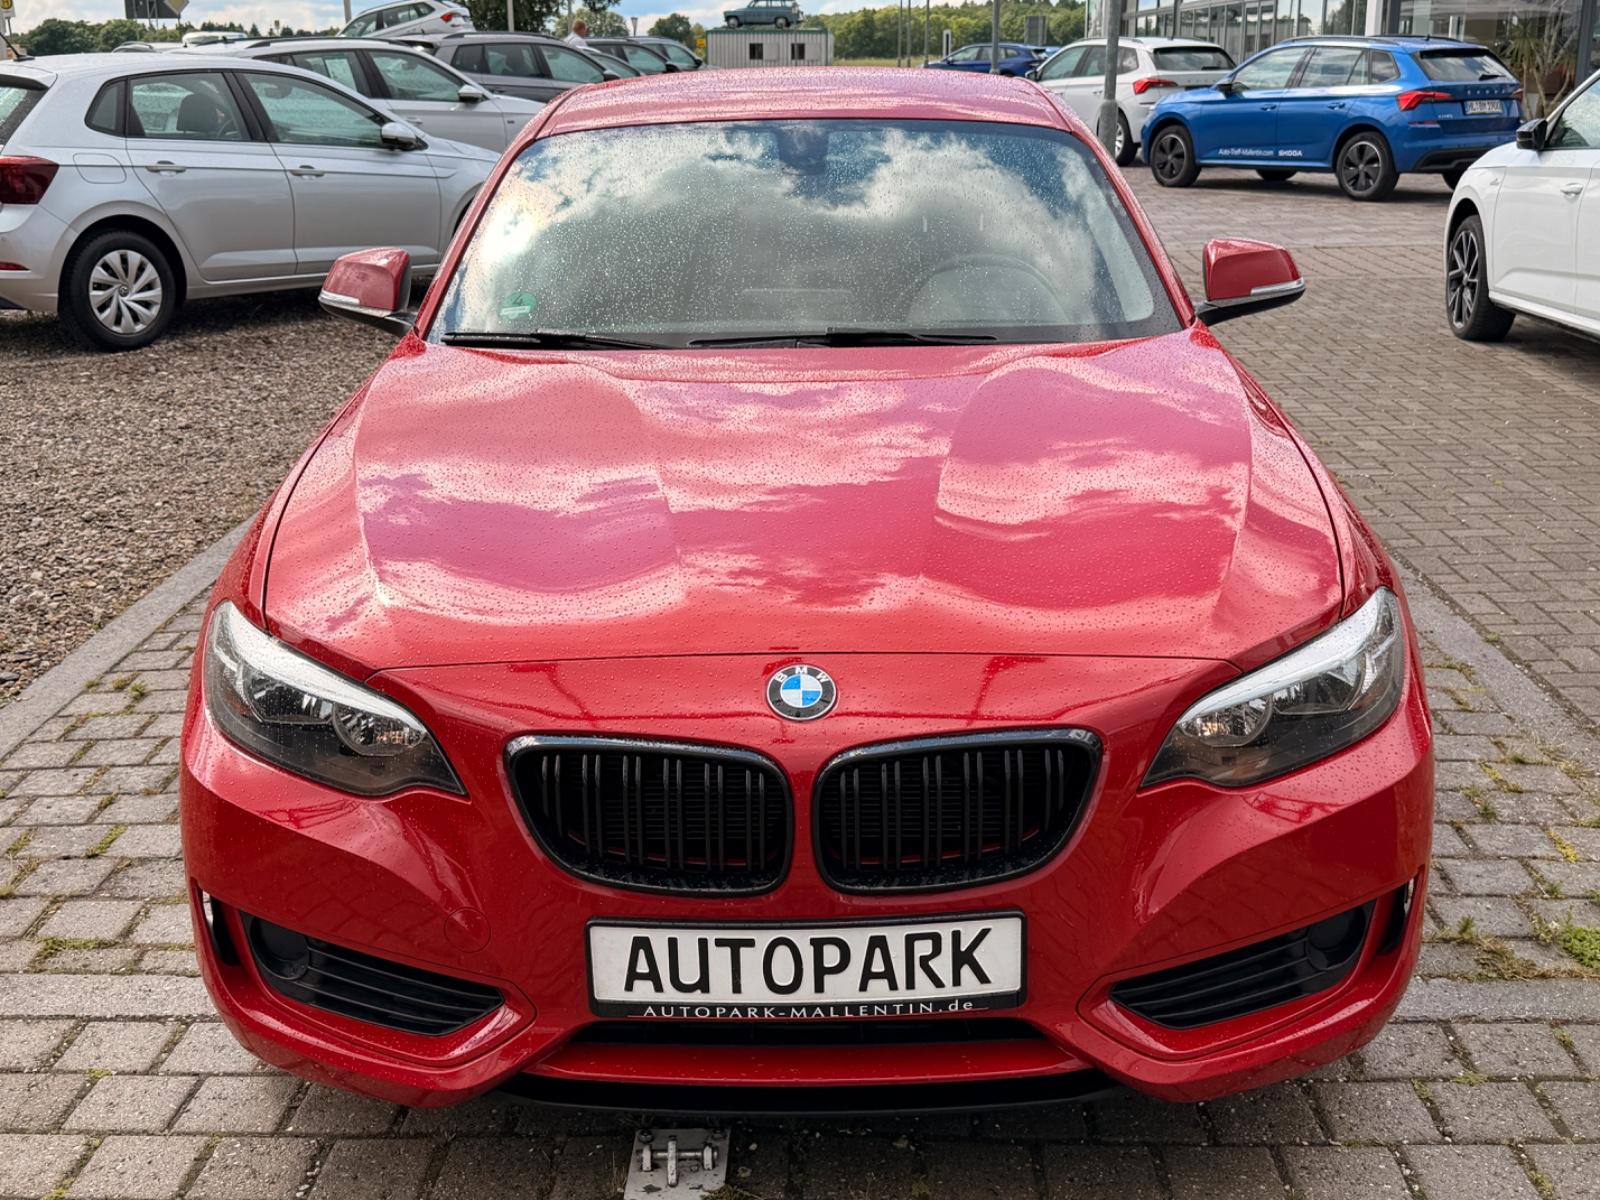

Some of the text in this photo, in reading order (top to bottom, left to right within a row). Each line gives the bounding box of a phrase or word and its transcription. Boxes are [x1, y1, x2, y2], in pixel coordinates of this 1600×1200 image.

[775, 665, 830, 683] BMW
[623, 927, 993, 995] AUTOPARK
[643, 999, 975, 1019] AUTOPARK-MALLENTIN.de
